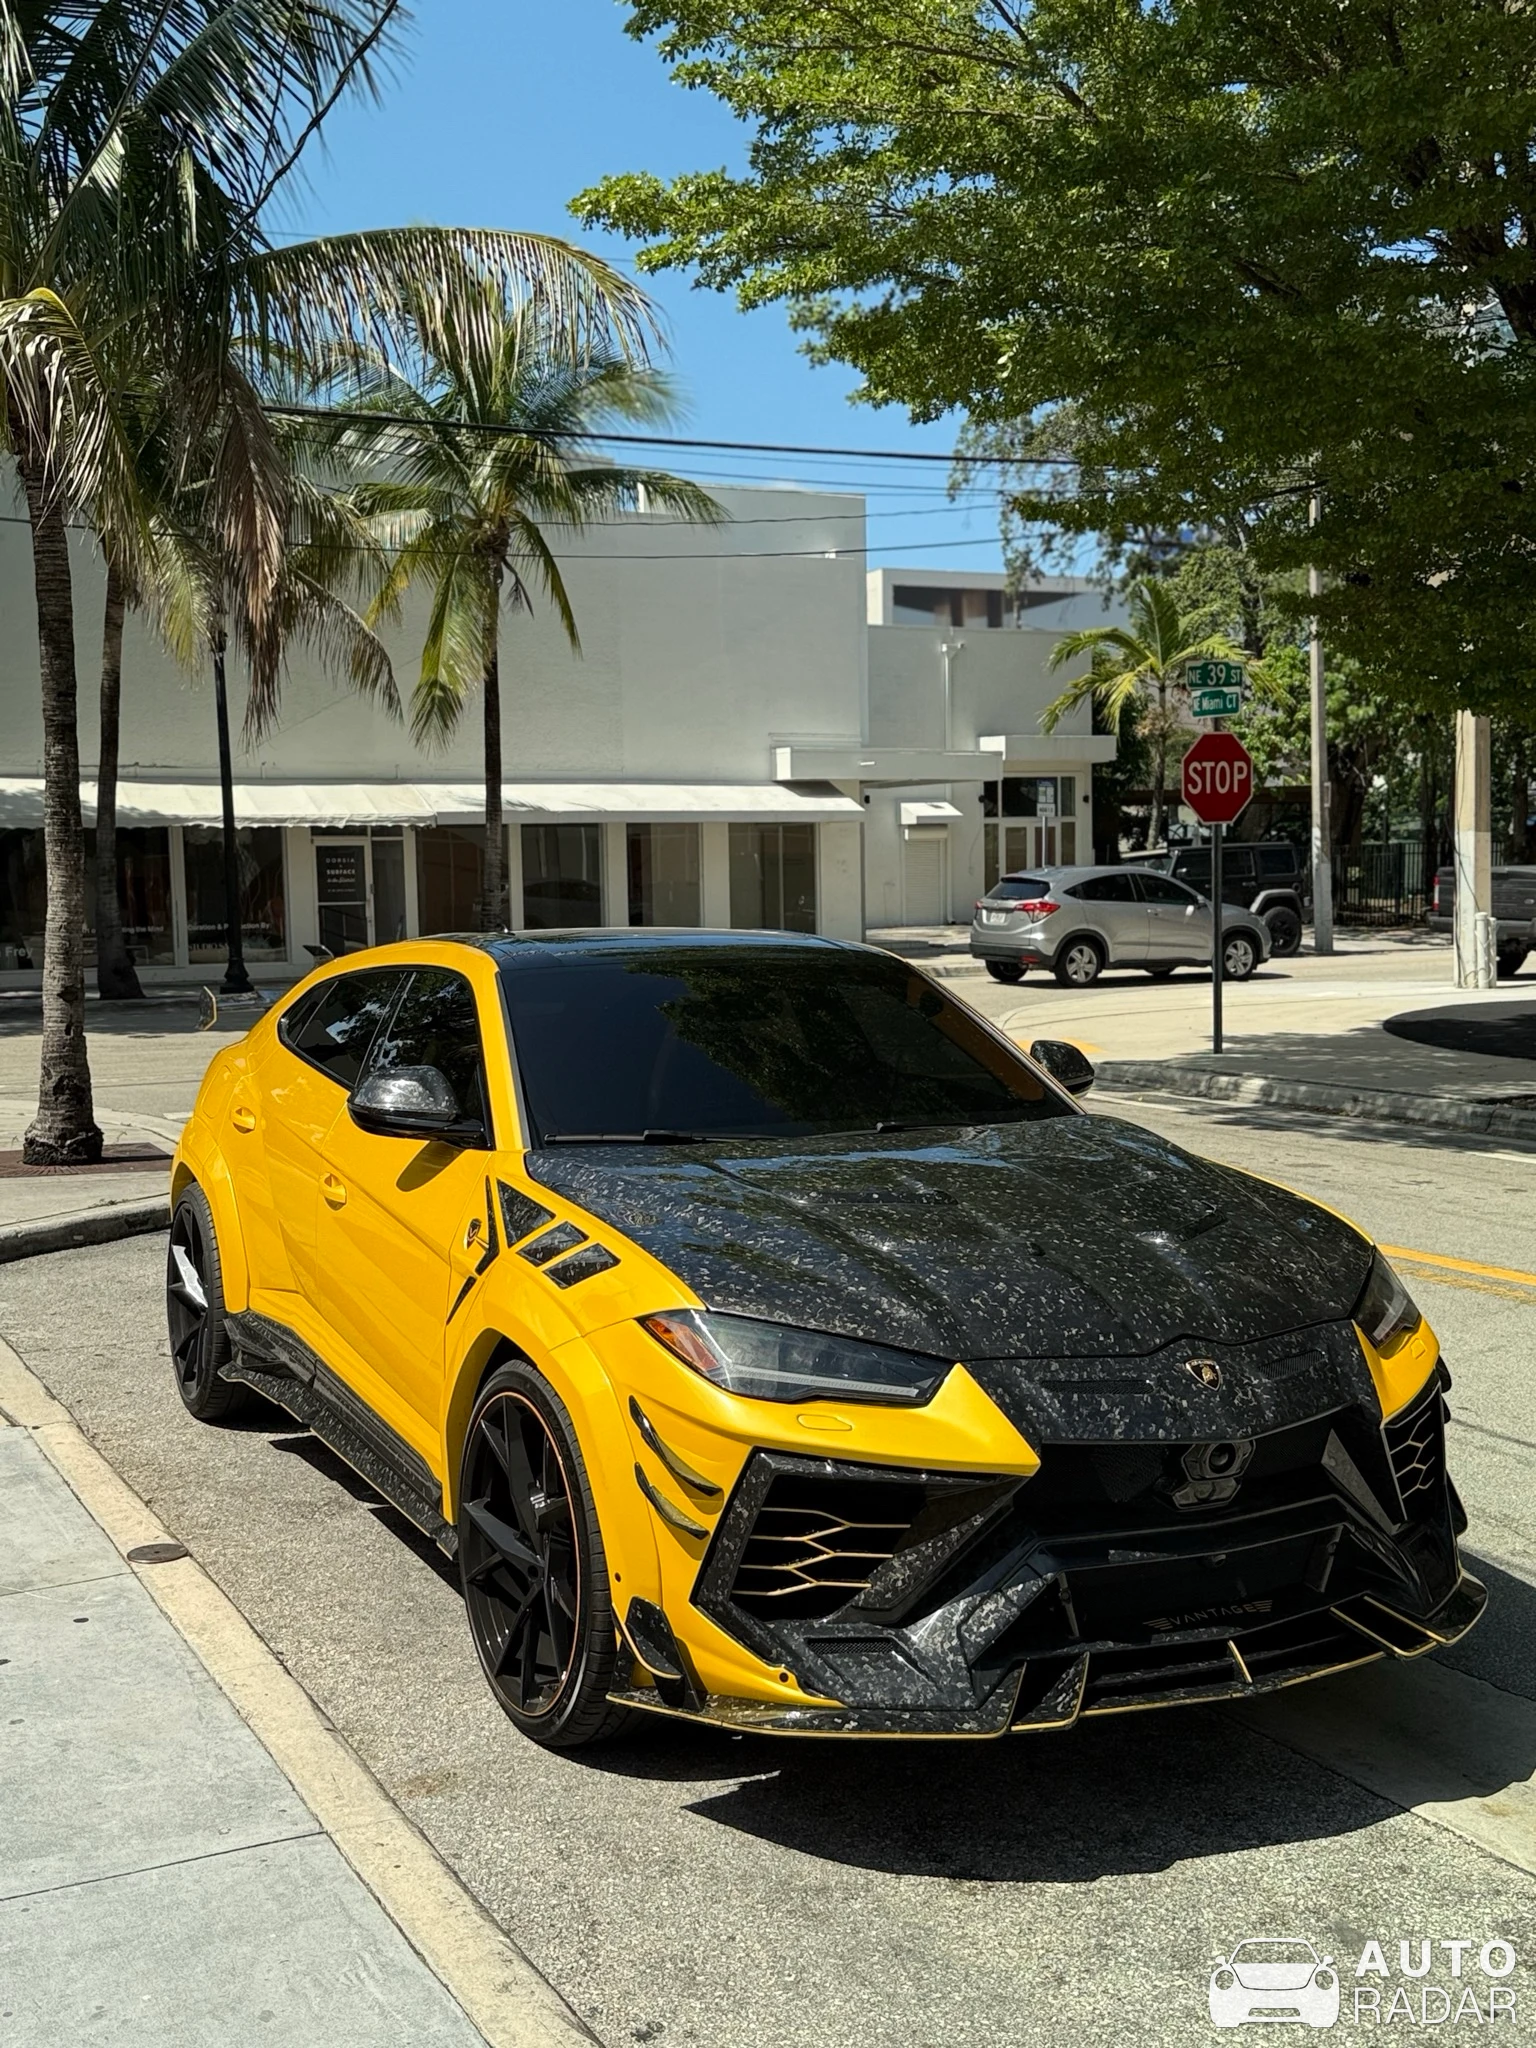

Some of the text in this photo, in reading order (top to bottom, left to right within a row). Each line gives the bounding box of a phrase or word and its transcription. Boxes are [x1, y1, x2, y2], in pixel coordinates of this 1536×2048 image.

[1188, 664, 1241, 686] NE 39 ST
[1201, 695, 1223, 710] Miami
[1226, 694, 1237, 708] CT
[1187, 761, 1248, 794] STOP
[1169, 1603, 1257, 1625] VANTAGE
